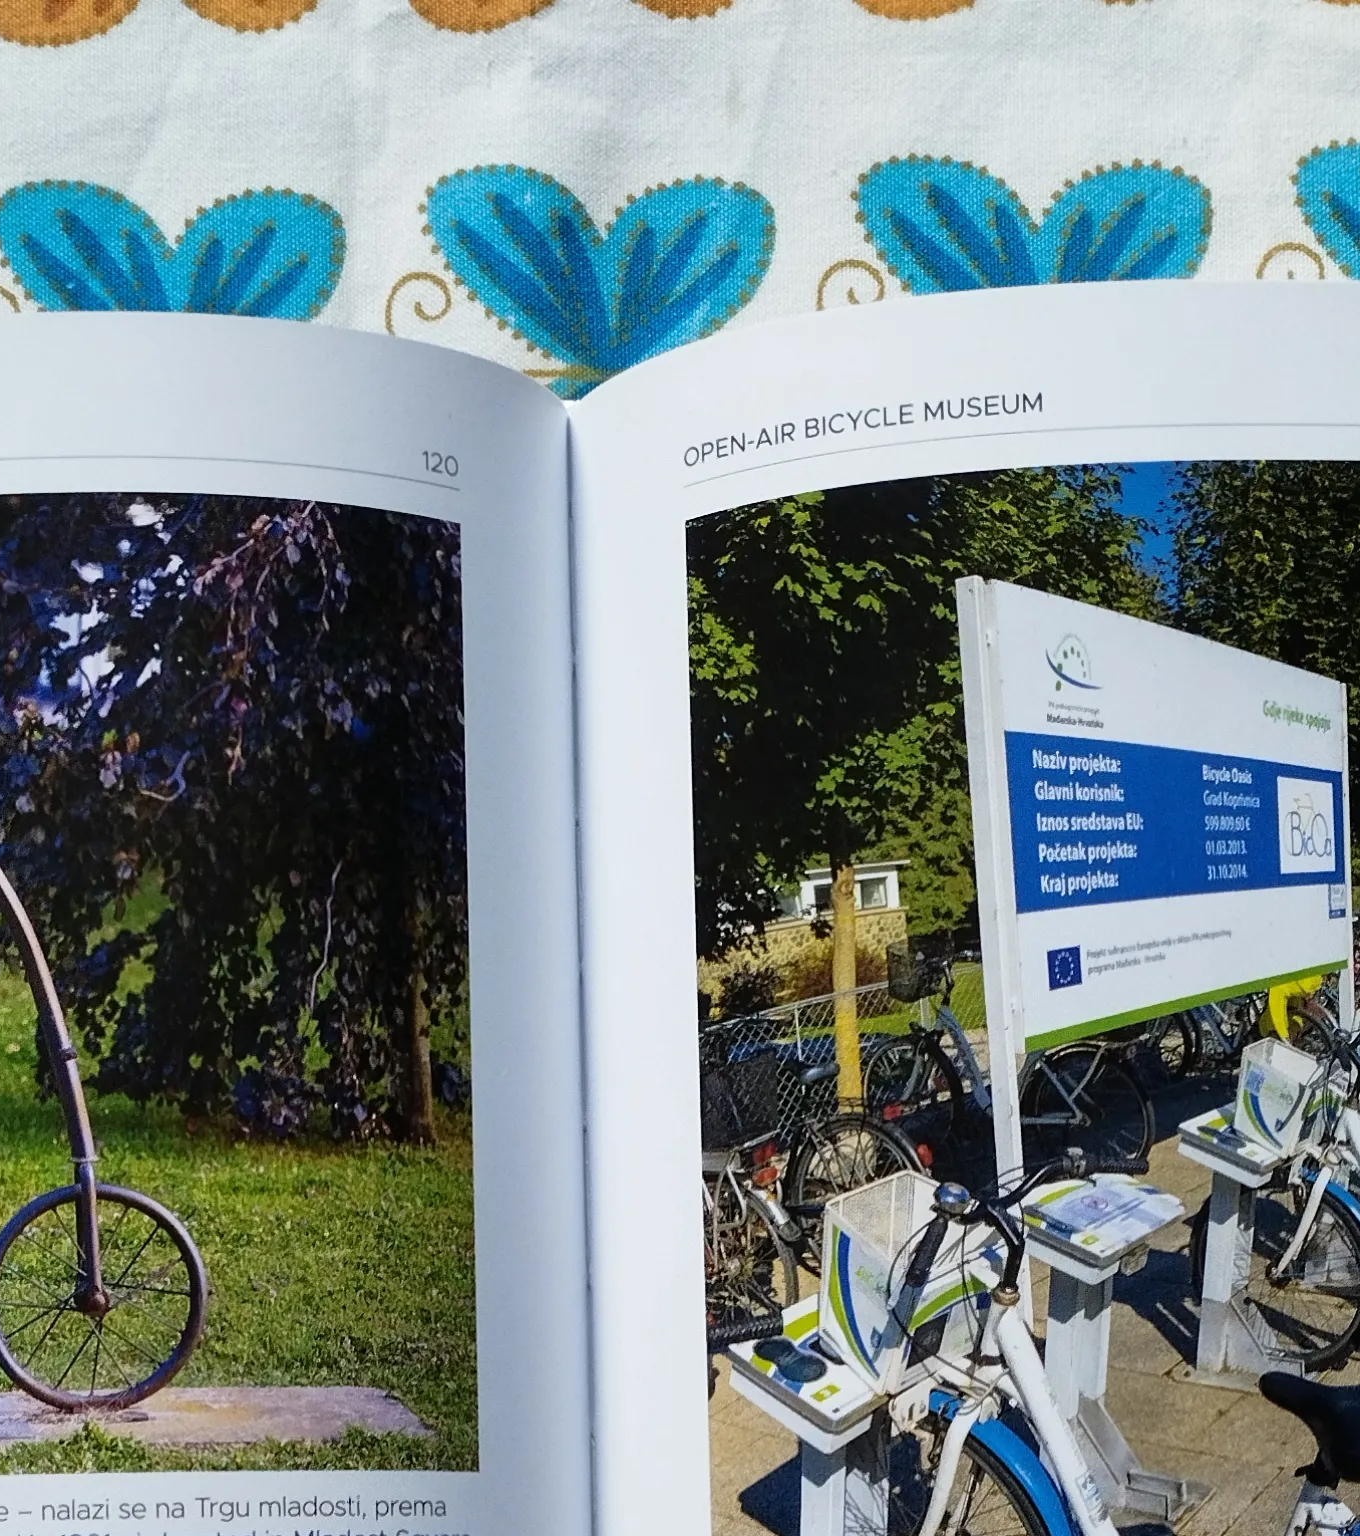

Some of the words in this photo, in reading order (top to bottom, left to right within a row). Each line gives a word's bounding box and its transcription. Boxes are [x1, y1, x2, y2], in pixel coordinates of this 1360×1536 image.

[683, 422, 796, 467] OPEN-AIR
[804, 403, 915, 440] BICYCLE
[923, 392, 1044, 422] MUSEUM
[422, 450, 459, 477] 120
[1032, 749, 1067, 769] Naziv
[1069, 753, 1122, 776] projekta:
[1202, 764, 1231, 785] Bicycle
[1034, 780, 1073, 801] Glavni
[1075, 781, 1125, 802] korisnik:
[1203, 790, 1222, 806] Grad
[1036, 812, 1069, 832] Iznos
[1070, 812, 1125, 831] sredstava
[1125, 812, 1144, 831] EU:
[1038, 841, 1086, 863] Početak
[1087, 840, 1138, 865] projekta:
[1040, 874, 1066, 897] Kraj
[1067, 870, 1119, 896] projekta:
